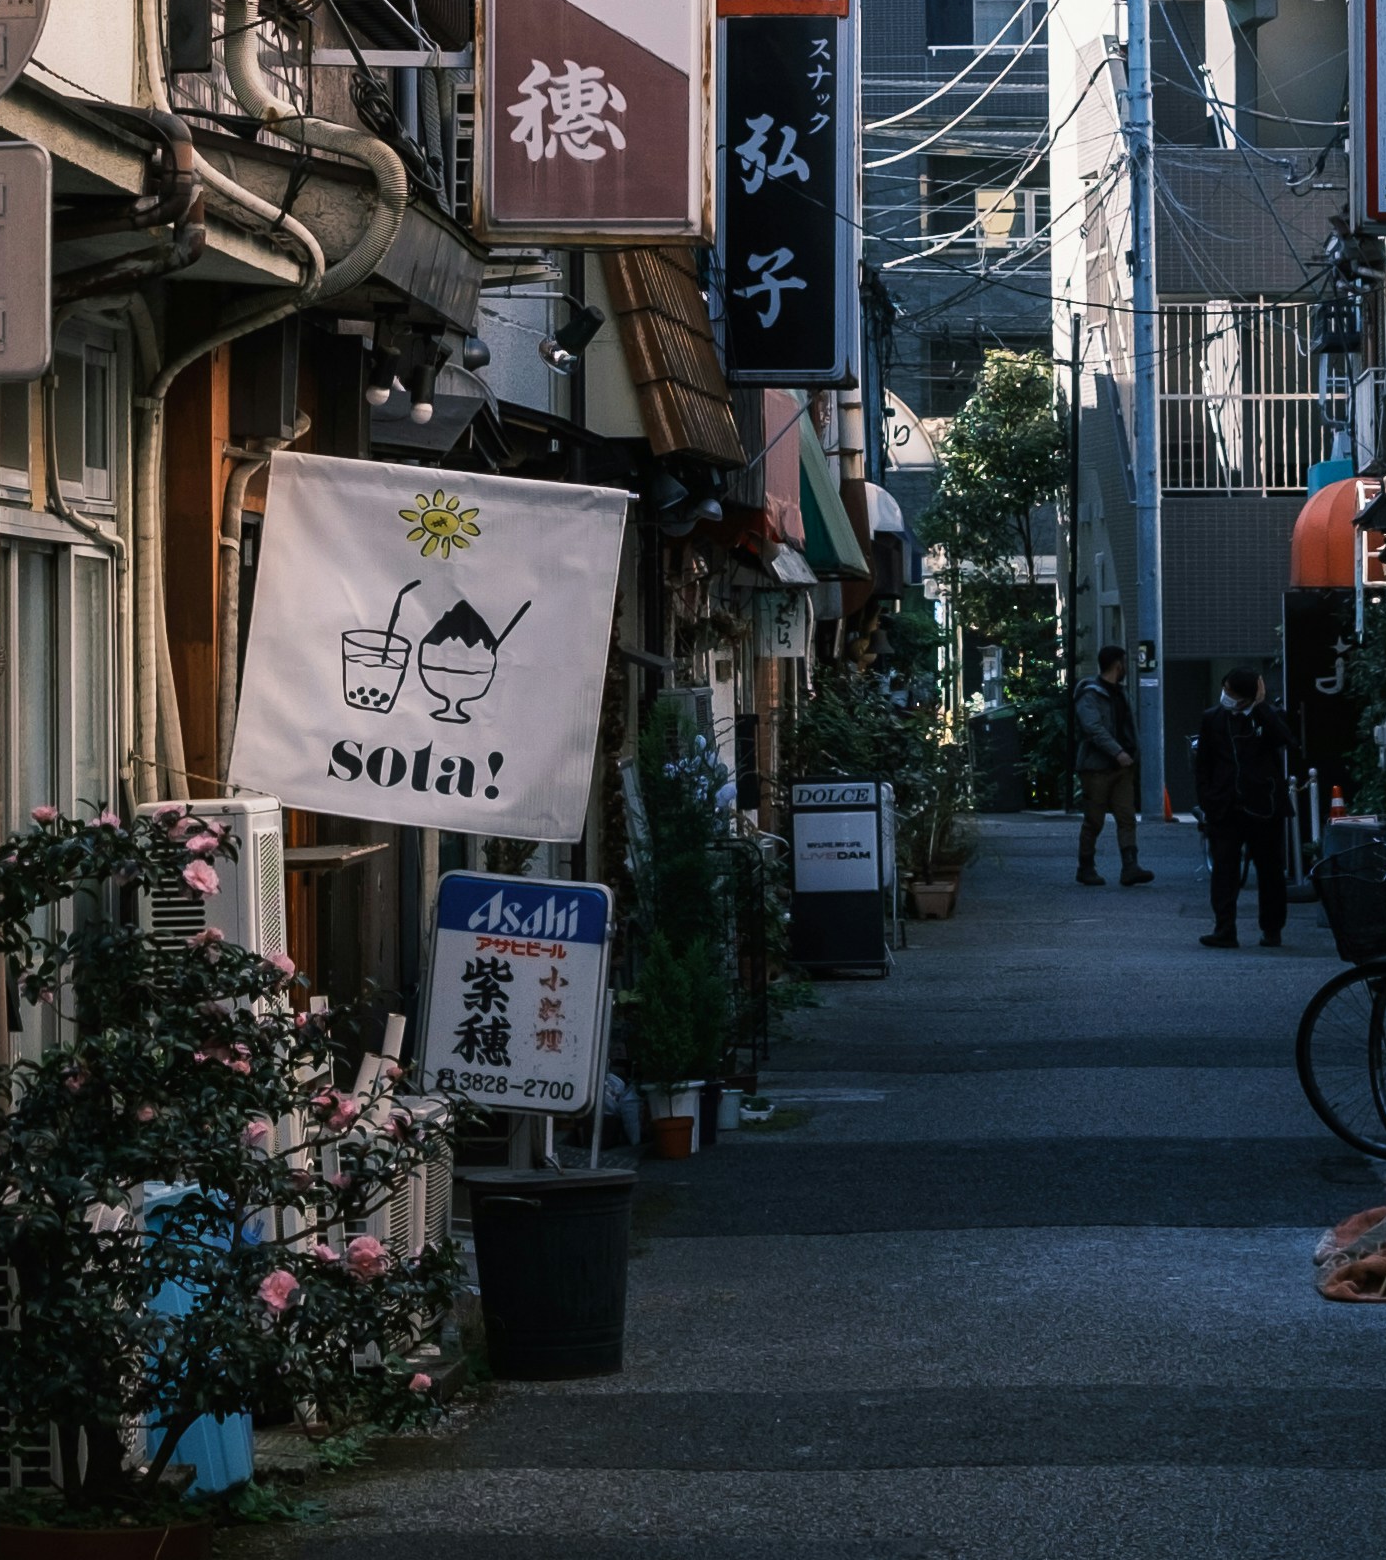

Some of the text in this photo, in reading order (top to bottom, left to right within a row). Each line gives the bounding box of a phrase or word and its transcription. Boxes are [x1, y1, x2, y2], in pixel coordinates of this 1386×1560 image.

[807, 38, 831, 135] スナック
[733, 113, 810, 329] 弘子
[327, 739, 504, 800] sota!
[796, 788, 870, 803] DOLCE
[468, 890, 580, 939] Asahi
[475, 936, 567, 959] アサヒビール
[459, 1071, 575, 1101] 3828-2700
